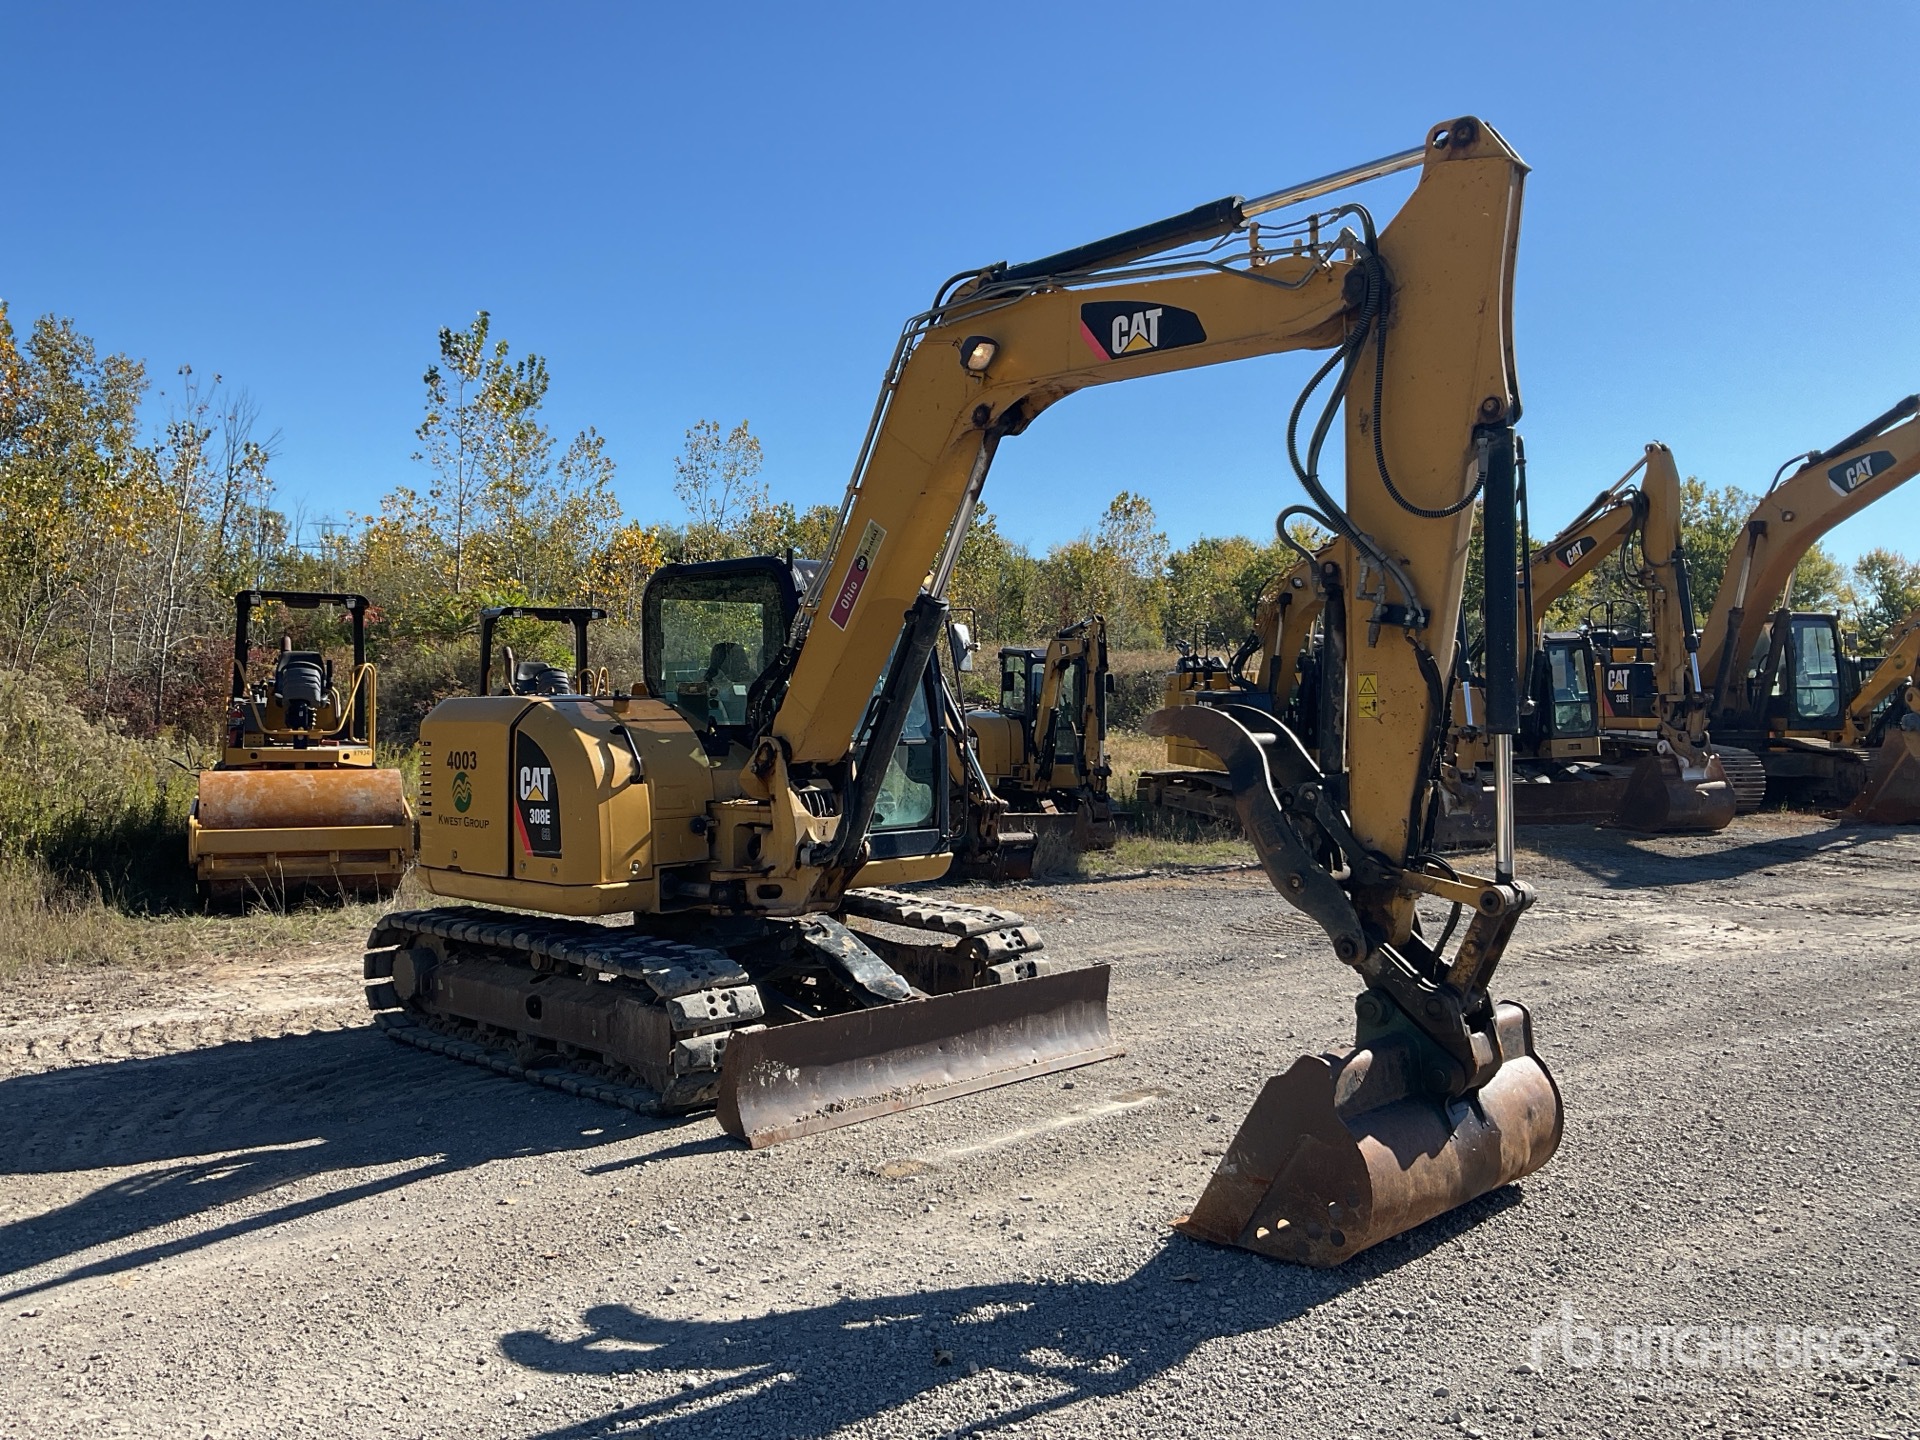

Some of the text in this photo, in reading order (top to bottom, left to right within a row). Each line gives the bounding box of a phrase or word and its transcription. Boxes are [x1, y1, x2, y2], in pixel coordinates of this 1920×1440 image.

[1112, 308, 1172, 354] CAT
[1846, 455, 1873, 489] CAT
[1566, 541, 1583, 566] CAT
[841, 581, 858, 609] Ohio
[864, 529, 879, 556] Rental
[1608, 669, 1630, 691] CAT
[446, 751, 477, 770] 4003
[520, 766, 551, 801] CAT
[463, 816, 490, 829] GROUP
[529, 808, 551, 825] 308E
